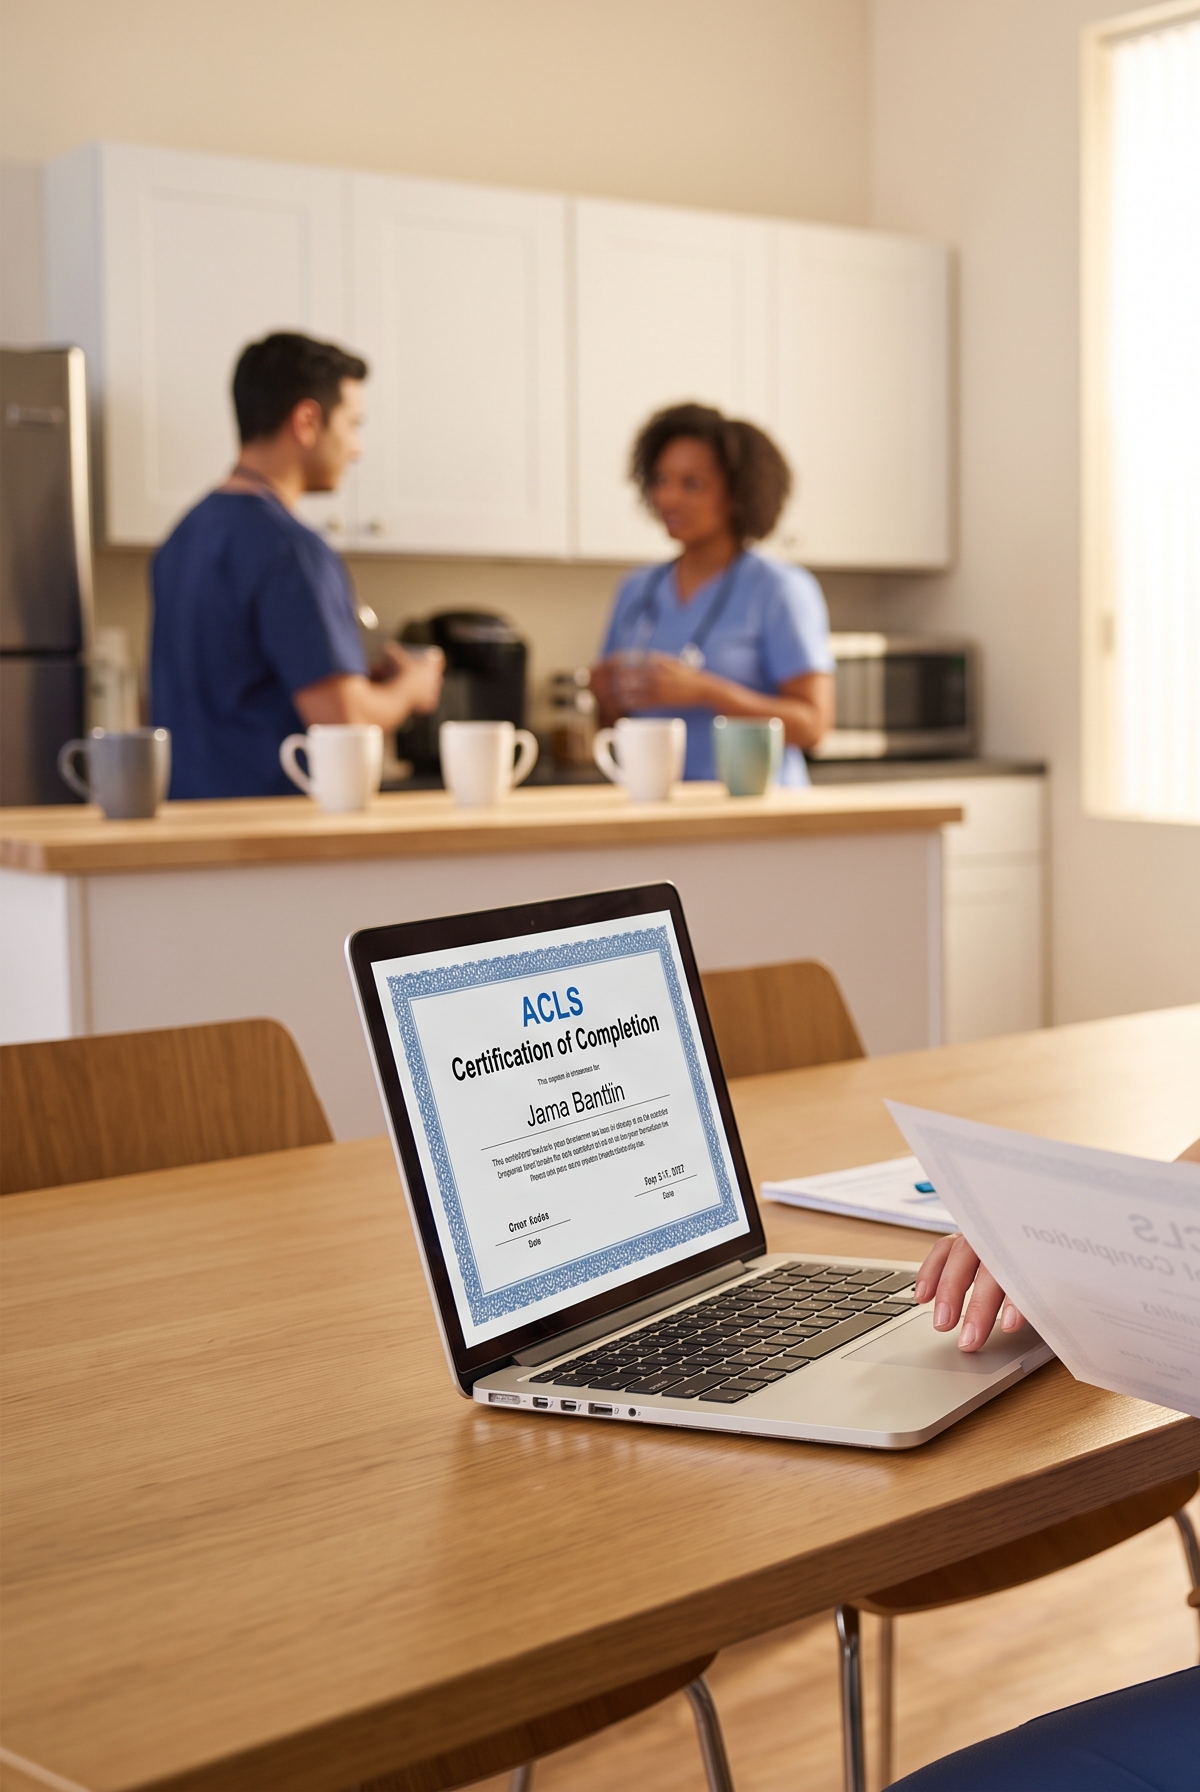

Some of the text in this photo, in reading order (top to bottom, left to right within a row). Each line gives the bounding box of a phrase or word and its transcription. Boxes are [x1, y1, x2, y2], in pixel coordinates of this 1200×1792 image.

[523, 987, 583, 1028] ACLS
[452, 1039, 555, 1081] Certification
[557, 1030, 573, 1055] of
[576, 1014, 660, 1049] Completion
[527, 1100, 570, 1127] Jama
